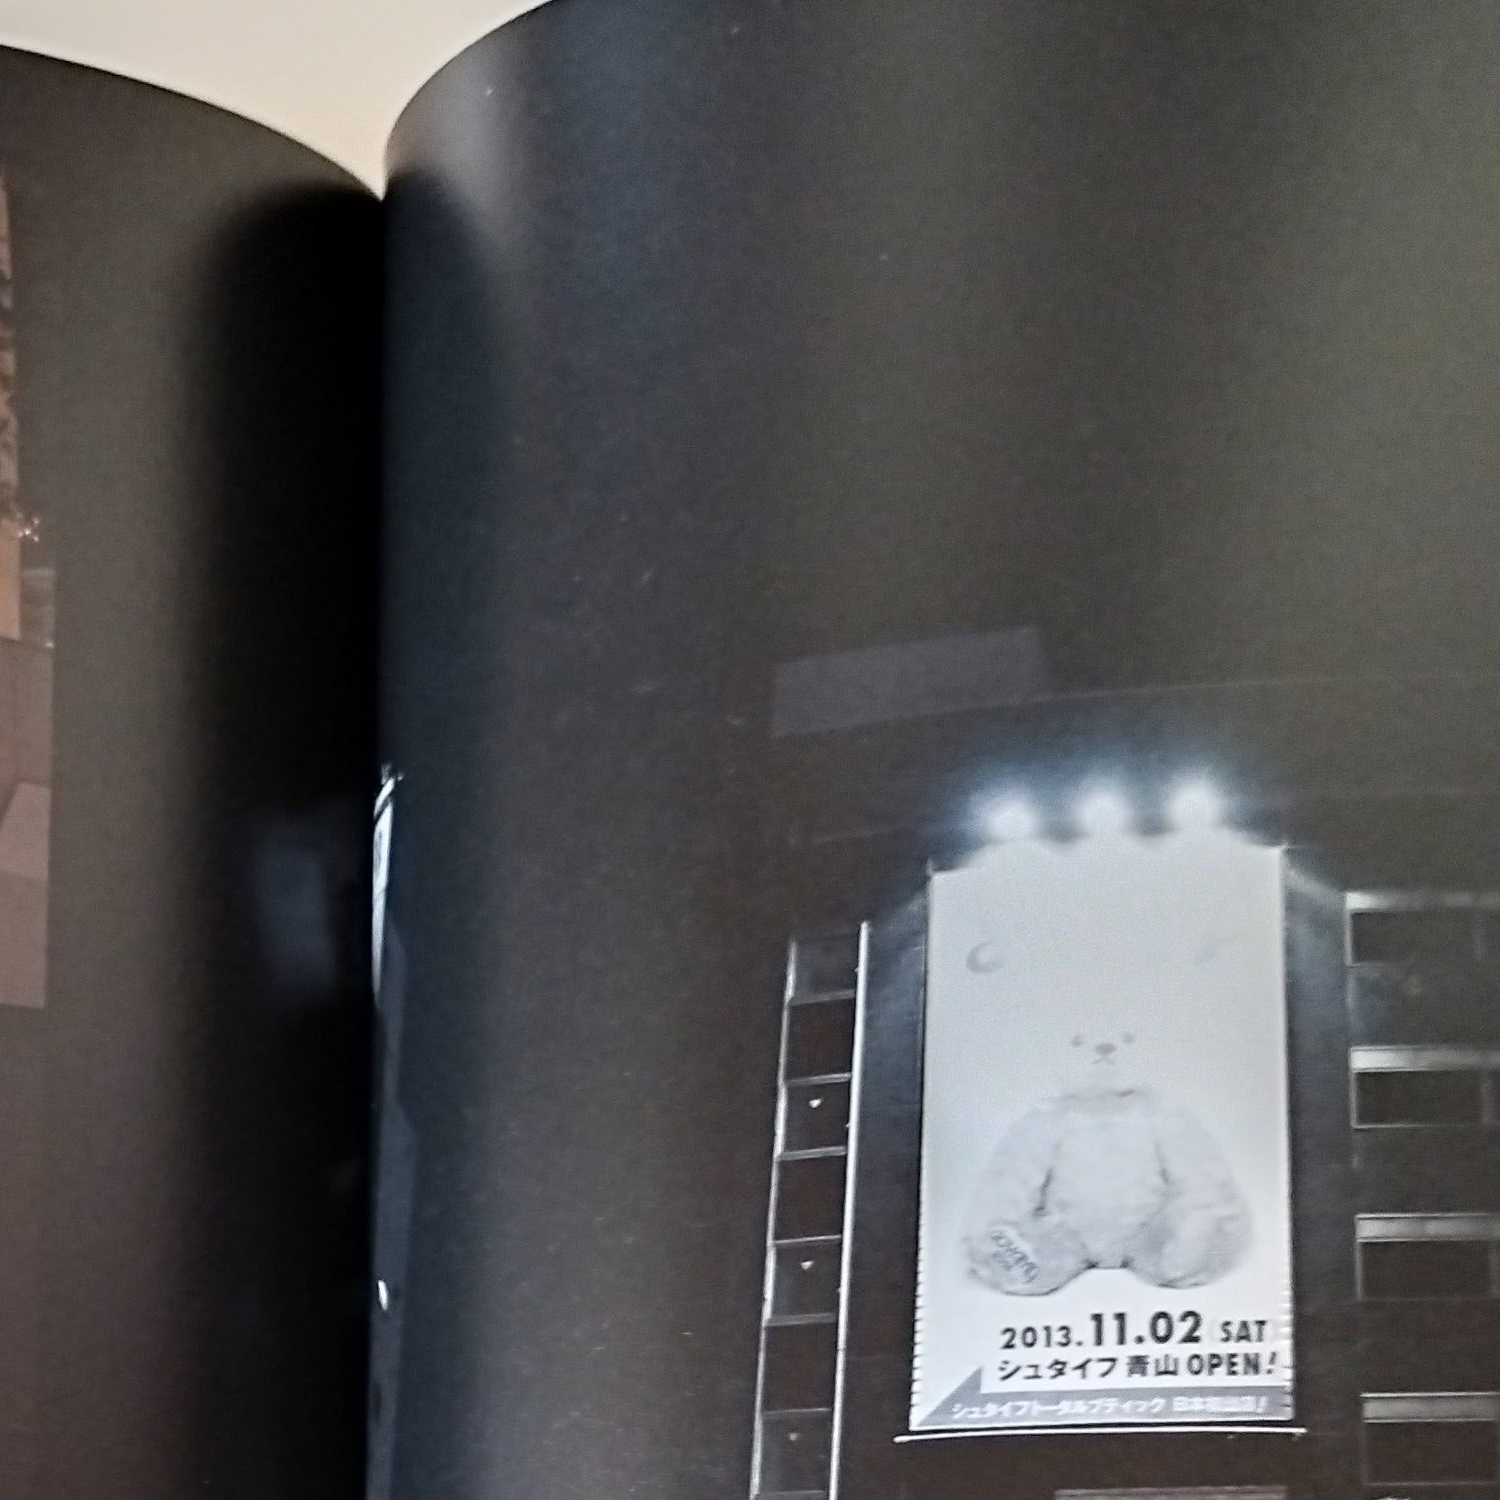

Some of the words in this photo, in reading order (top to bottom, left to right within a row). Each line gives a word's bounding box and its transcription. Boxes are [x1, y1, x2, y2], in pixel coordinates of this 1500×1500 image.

[1000, 1311, 1202, 1349] 2013.11.02
[1220, 1320, 1267, 1343] SAT
[1187, 1352, 1277, 1375] OPEN!
